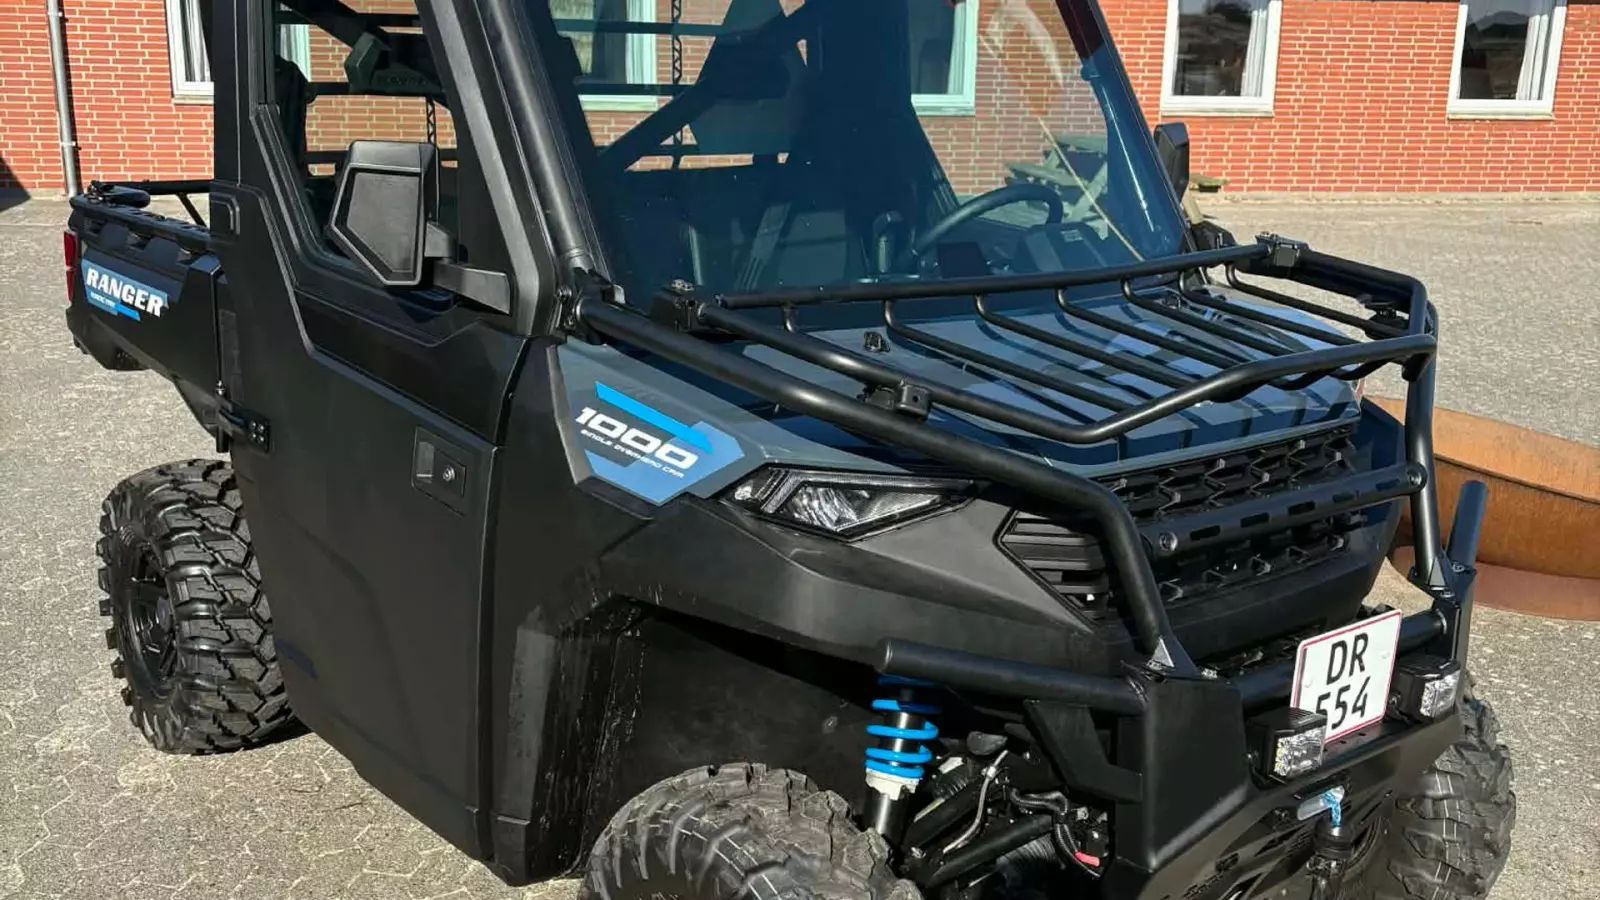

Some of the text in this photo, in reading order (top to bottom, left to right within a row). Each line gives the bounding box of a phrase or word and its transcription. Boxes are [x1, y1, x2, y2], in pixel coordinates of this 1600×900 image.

[86, 268, 164, 317] RANGER
[575, 406, 699, 470] 1000
[580, 429, 612, 446] SINGLE
[1326, 632, 1369, 686] DR
[1315, 676, 1371, 730] 554
